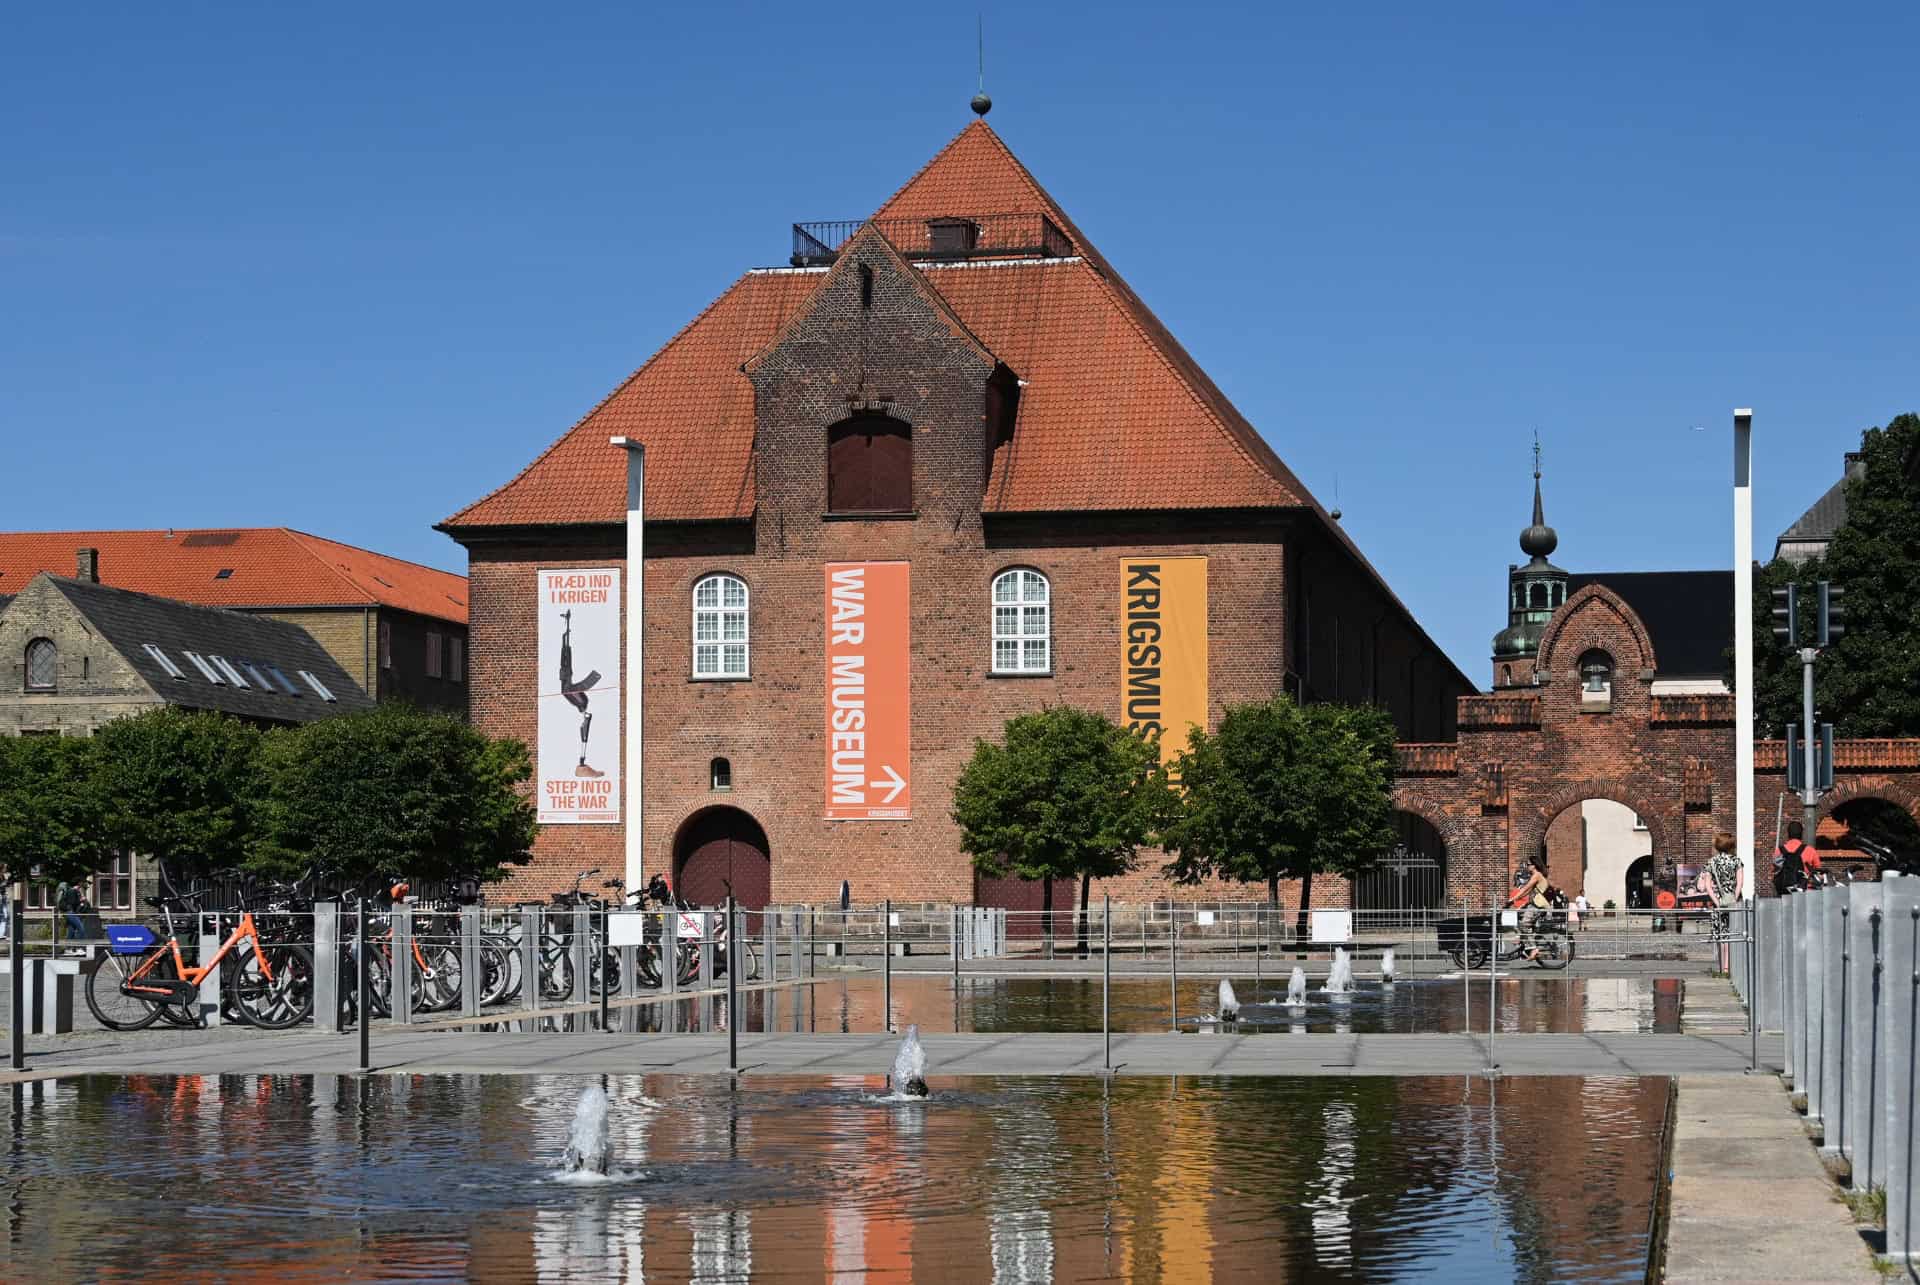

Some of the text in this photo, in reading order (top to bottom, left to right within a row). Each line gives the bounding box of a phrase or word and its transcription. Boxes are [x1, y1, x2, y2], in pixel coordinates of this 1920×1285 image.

[547, 574, 612, 589] TRÆD IND
[551, 589, 607, 604] I KRIGEN
[831, 567, 865, 804] WAR MUSEUM
[546, 780, 612, 794] STEP INTO
[550, 795, 608, 809] THE WAR
